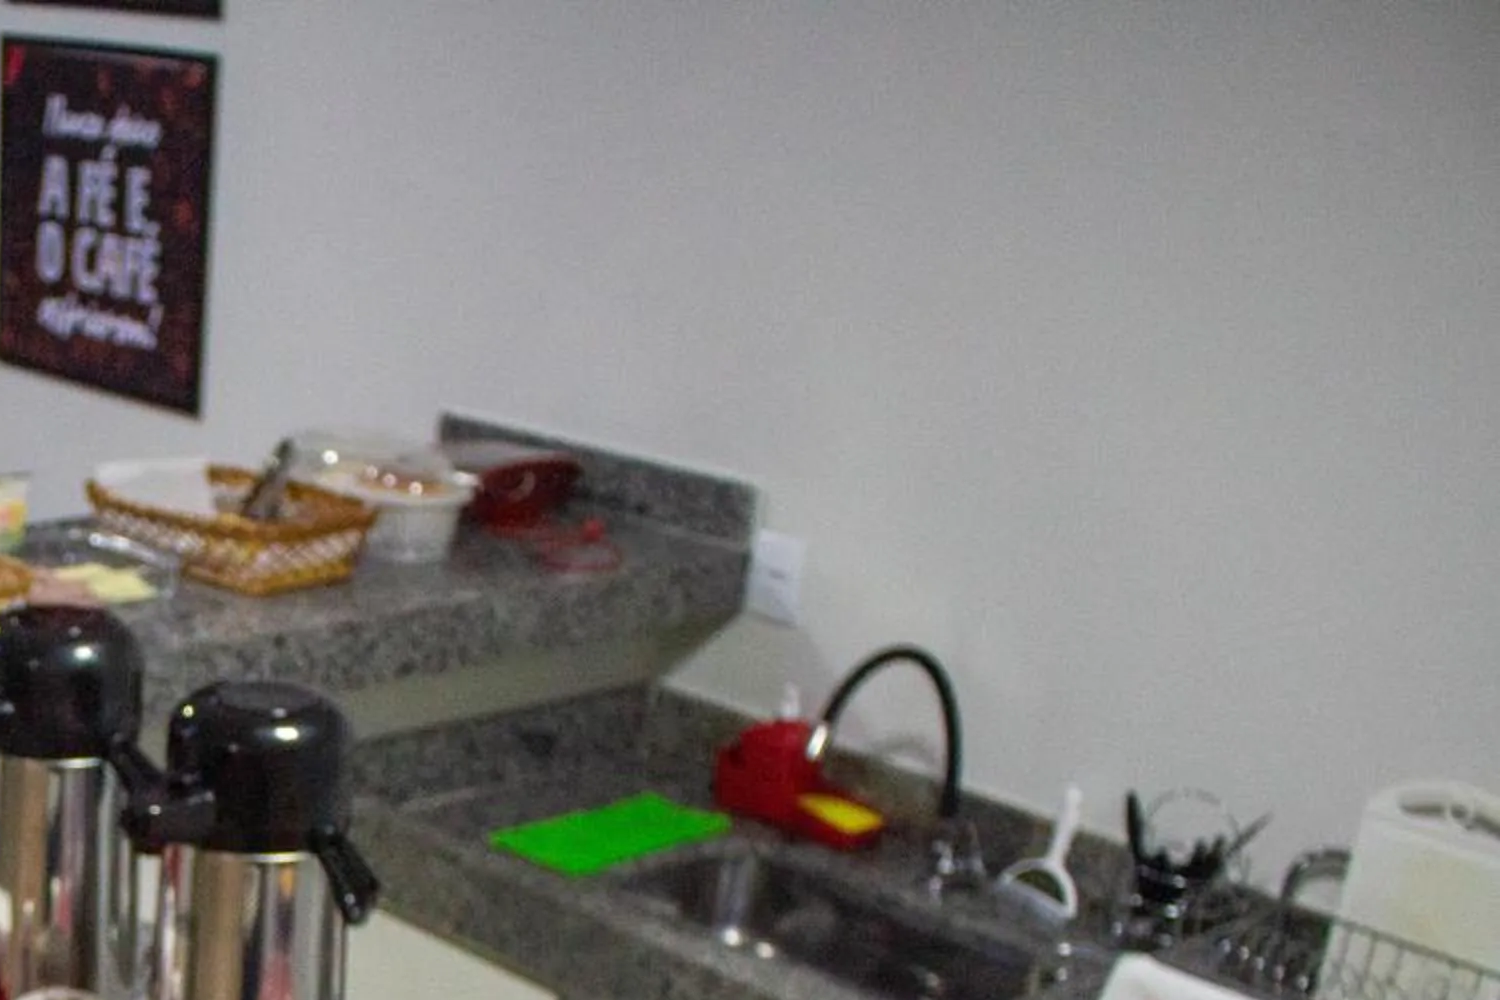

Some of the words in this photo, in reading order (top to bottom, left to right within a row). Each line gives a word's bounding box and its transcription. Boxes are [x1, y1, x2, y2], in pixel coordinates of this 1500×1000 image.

[39, 154, 70, 218] A
[124, 165, 152, 233] E
[37, 220, 66, 284] O
